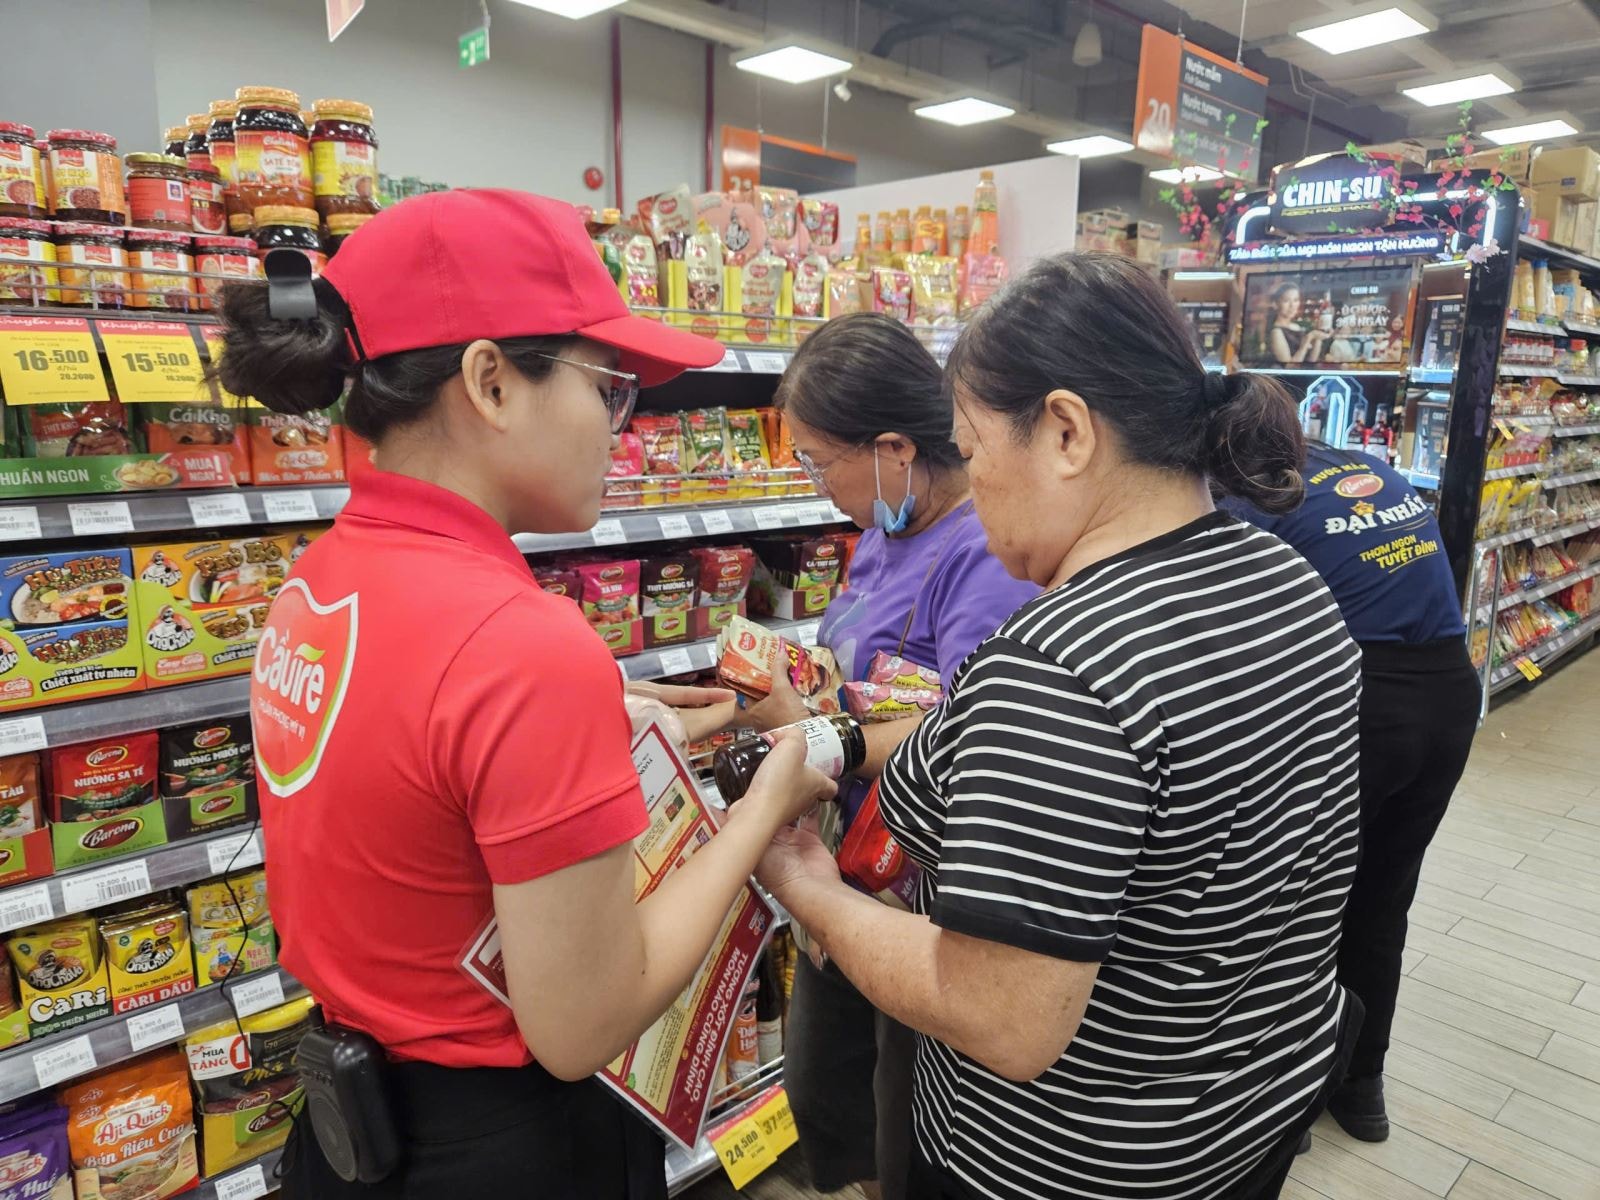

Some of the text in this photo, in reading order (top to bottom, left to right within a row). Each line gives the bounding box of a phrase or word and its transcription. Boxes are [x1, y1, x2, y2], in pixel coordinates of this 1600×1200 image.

[1283, 176, 1382, 207] CHIN-SU
[13, 349, 90, 372] 16.500
[121, 352, 191, 373] 15.500
[46, 468, 90, 484] NGON
[184, 457, 214, 471] MUA
[1324, 513, 1378, 535] ĐẠI
[1359, 534, 1417, 562] THƠM NGON
[1375, 540, 1438, 569] TUYỆT ĐỈNH
[41, 676, 70, 691] Chiết
[69, 670, 94, 683] xuất
[106, 668, 136, 679] nhiên
[74, 765, 145, 788] NƯỚNG SA TẾ
[84, 820, 137, 847] Barona
[725, 952, 749, 999] TƯƠNG
[726, 947, 741, 978] MÓN
[710, 978, 728, 1011] NÀO
[713, 1000, 729, 1030] XỐT
[695, 1011, 714, 1056] CŨNG
[190, 1056, 230, 1072] TẶNG
[202, 1047, 225, 1058] MUA
[690, 1069, 707, 1103] CAO,
[96, 1103, 170, 1145] Aji-Quick
[120, 1137, 155, 1158] Riêu
[158, 1124, 185, 1144] Cua
